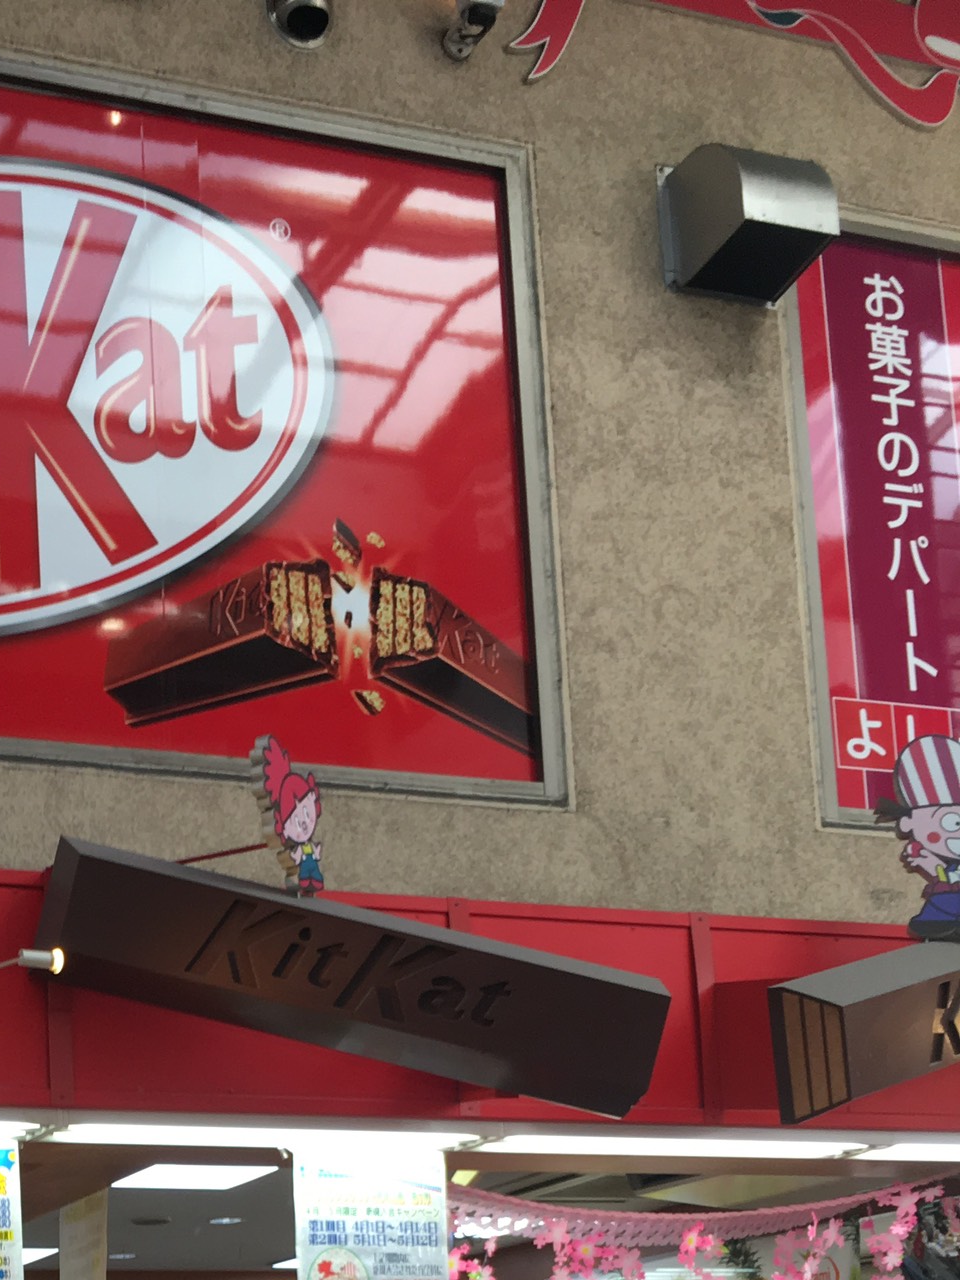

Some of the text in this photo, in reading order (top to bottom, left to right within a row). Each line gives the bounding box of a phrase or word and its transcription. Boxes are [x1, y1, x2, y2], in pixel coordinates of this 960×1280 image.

[861, 273, 939, 693] お菓子のデパート
